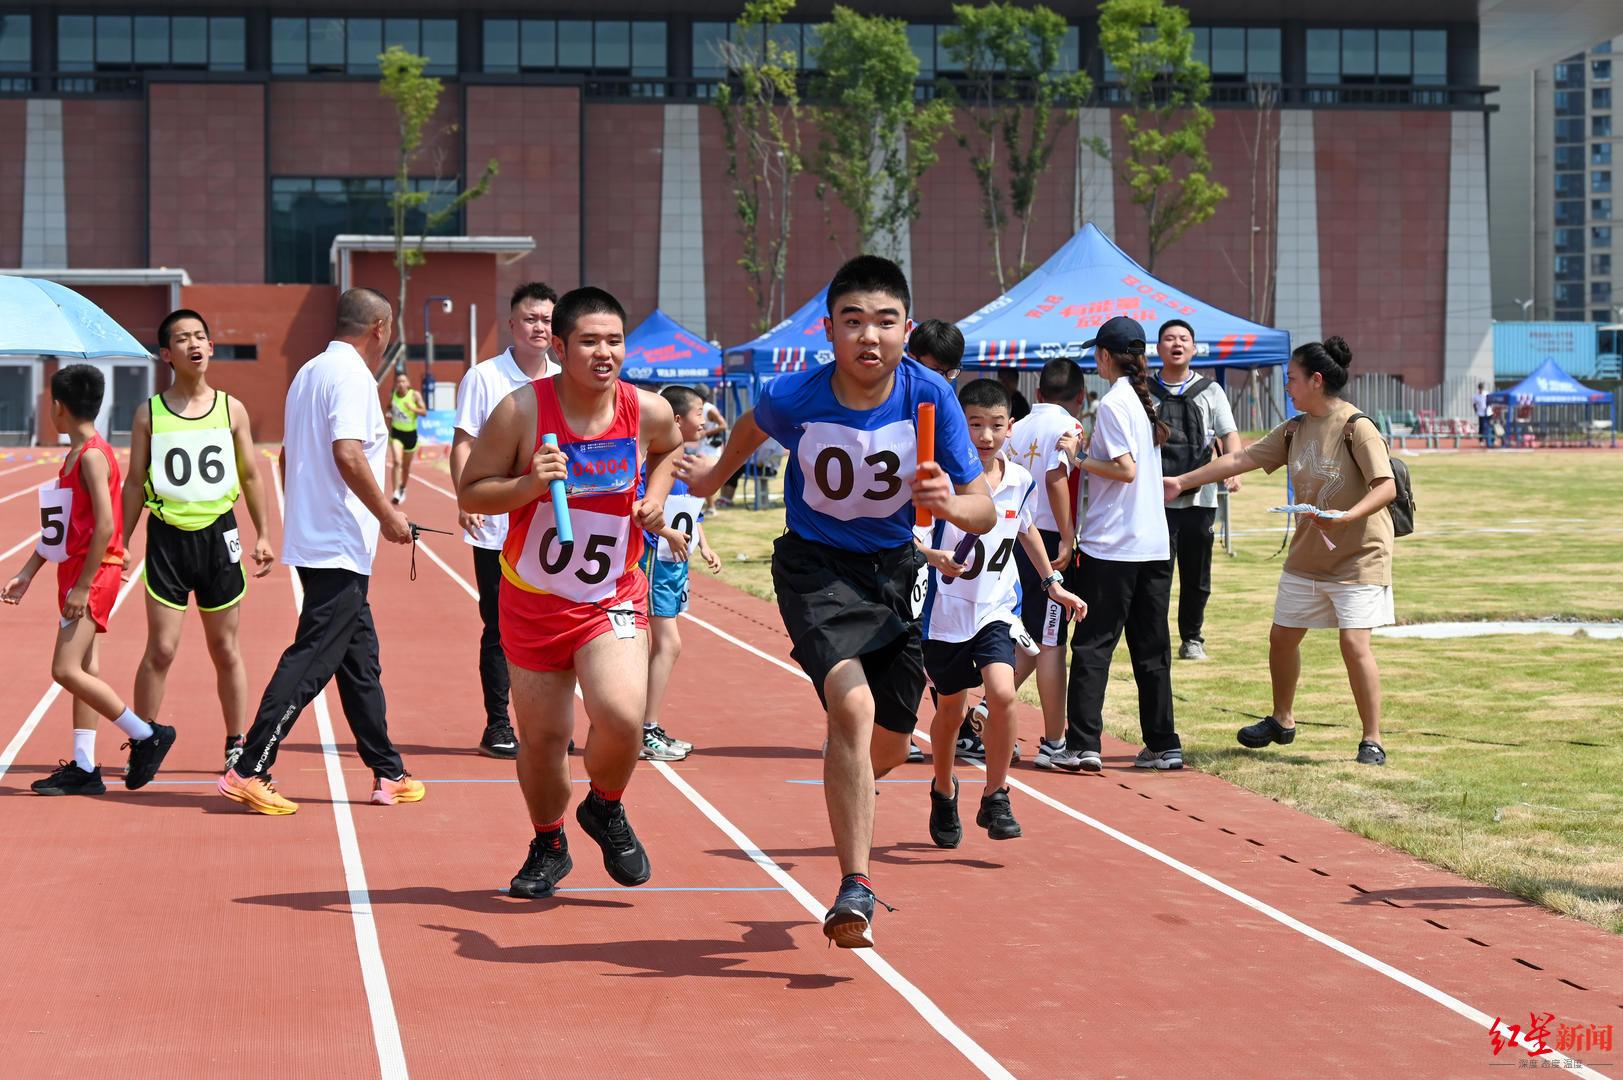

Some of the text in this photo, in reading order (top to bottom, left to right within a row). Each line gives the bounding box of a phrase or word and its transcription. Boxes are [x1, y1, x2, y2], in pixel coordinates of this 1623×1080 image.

[164, 445, 225, 487] 06
[572, 457, 629, 478] 04004
[814, 446, 903, 501] 03
[538, 526, 618, 585] 05
[955, 537, 1015, 581] 04
[1048, 604, 1059, 629] CHINA
[253, 734, 278, 773] ARMOUR
